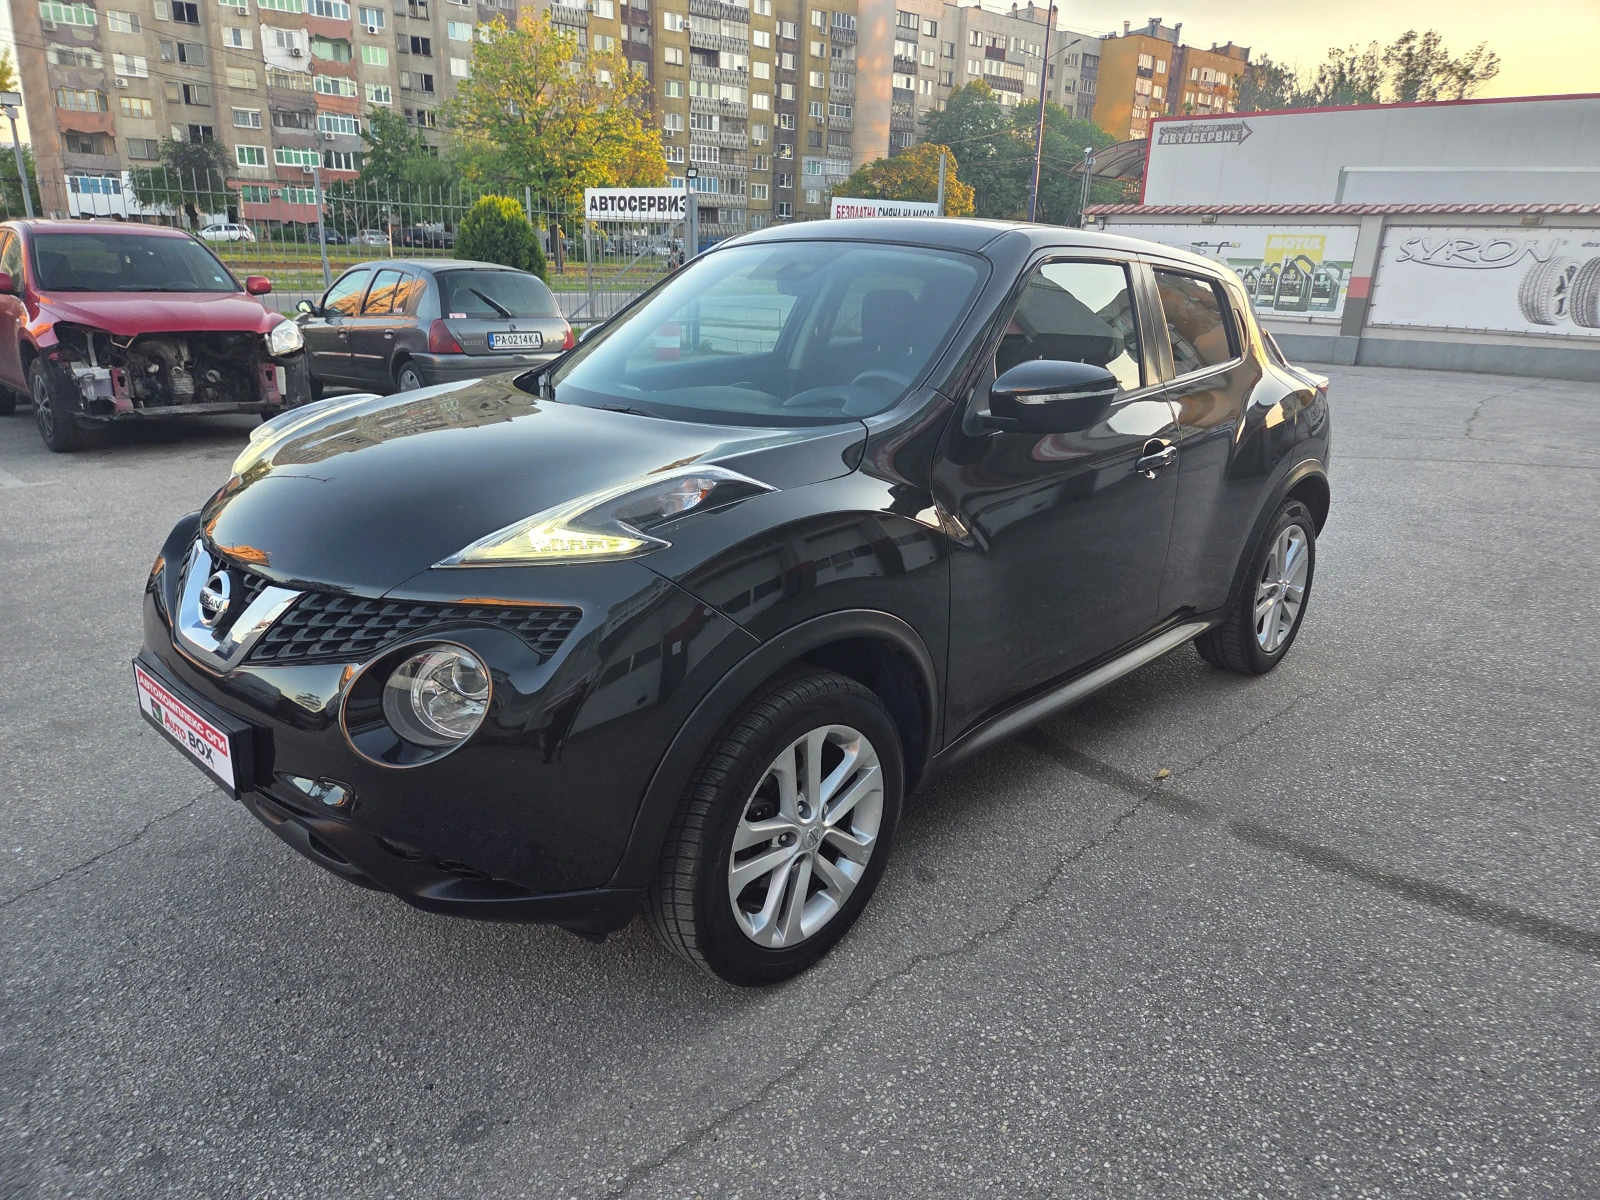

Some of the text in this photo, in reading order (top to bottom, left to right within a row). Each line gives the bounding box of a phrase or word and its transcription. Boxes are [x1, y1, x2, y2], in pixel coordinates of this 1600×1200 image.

[1161, 130, 1239, 144] АВТОСЕРВИЗ
[589, 195, 687, 212] АВТОСЕРВИЗ
[1269, 237, 1322, 249] MOTUL
[1396, 237, 1560, 269] SYRON
[139, 675, 226, 752] АВТОКОМПЛЕКС ОГИ
[187, 729, 215, 764] BOX
